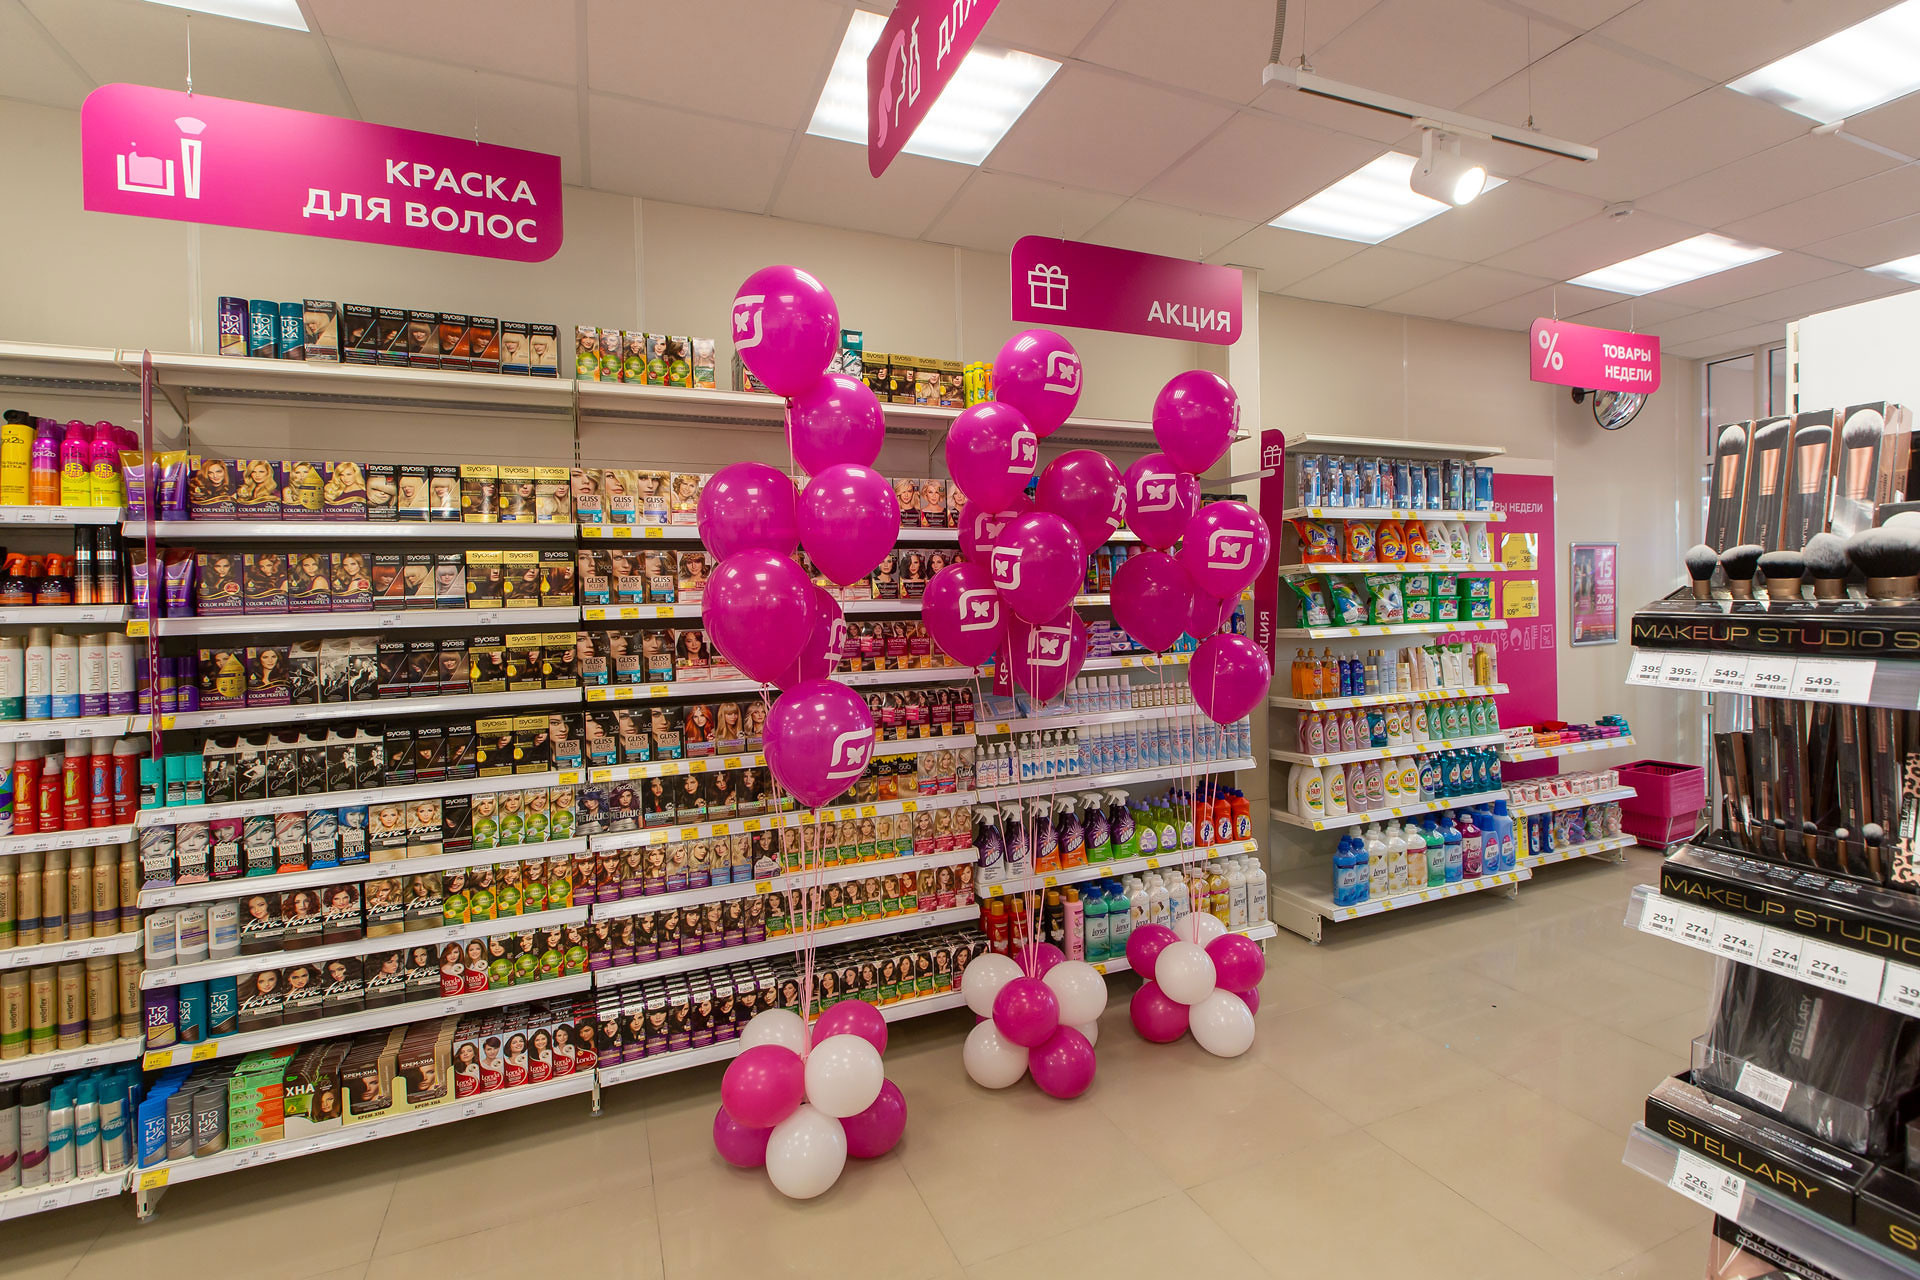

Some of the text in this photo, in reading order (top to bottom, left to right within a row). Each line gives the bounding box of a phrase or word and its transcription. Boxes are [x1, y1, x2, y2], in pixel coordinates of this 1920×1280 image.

[386, 158, 537, 206] КРАСКА
[302, 188, 537, 243] ДЛЯ ВОЛОС
[1147, 301, 1231, 333] АКЦИЯ
[1602, 344, 1651, 362] ТОВАРЫ
[1605, 365, 1652, 382] НЕДЕЛИ
[32, 450, 57, 458] got2b
[579, 495, 598, 503] GLISS
[1509, 502, 1544, 513] НЕДЕЛИ
[1354, 536, 1370, 549] Tide
[1384, 545, 1397, 554] Tide
[1598, 560, 1612, 578] 15
[1596, 594, 1614, 605] 20%
[1634, 624, 1749, 641] MAKEUP
[1757, 627, 1884, 647] STUDIO
[584, 657, 604, 665] GLISS
[593, 737, 613, 746] GLISS
[1664, 874, 1786, 916] MAKEUP
[1091, 927, 1107, 937] Lenor
[210, 994, 228, 1002] ТО
[148, 1005, 168, 1015] ТО
[210, 1005, 229, 1014] КА
[149, 1018, 168, 1026] КА
[1789, 994, 1813, 1056] STELLARY
[401, 1057, 434, 1068] КРЕМ-ХНА
[553, 1058, 572, 1068] Londa
[576, 1054, 597, 1065] Londa
[343, 1068, 377, 1079] КРЕМ-ХНА
[505, 1068, 524, 1079] Londa
[530, 1064, 549, 1075] Londa
[481, 1071, 500, 1082] Londa
[456, 1078, 475, 1088] Londa
[286, 1083, 315, 1097] ХНА
[170, 1113, 190, 1124] ТО
[198, 1110, 218, 1120] ТО
[170, 1126, 191, 1136] КА
[198, 1124, 218, 1133] КА
[1667, 1119, 1819, 1199] STELLARY
[1685, 1172, 1708, 1190] 226
